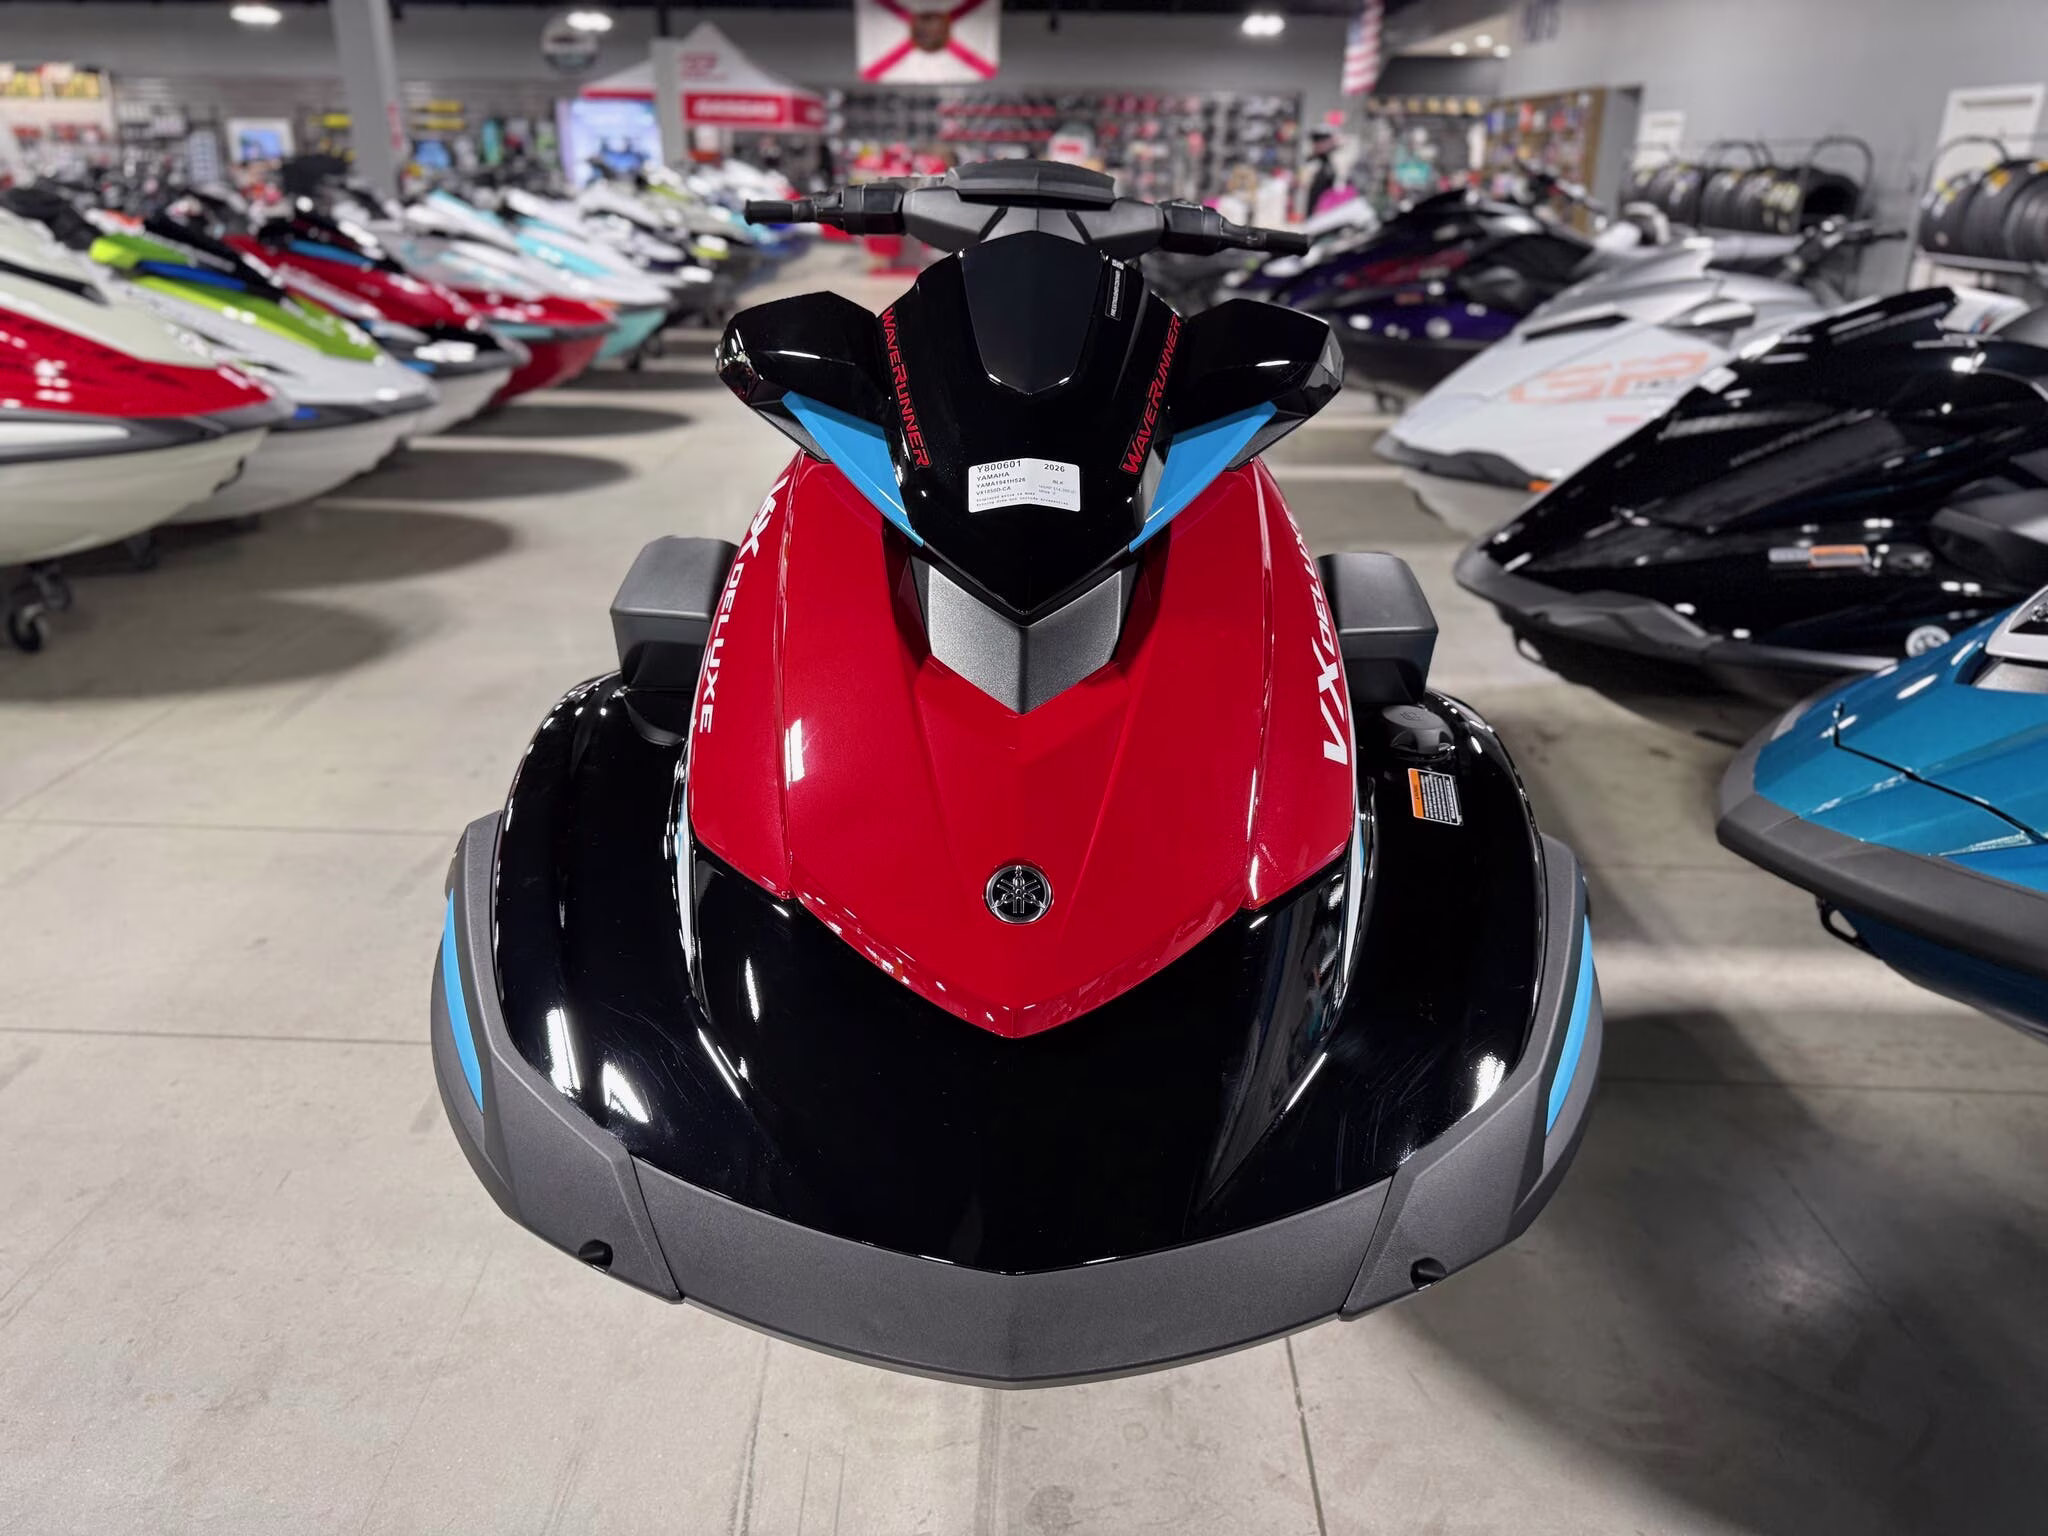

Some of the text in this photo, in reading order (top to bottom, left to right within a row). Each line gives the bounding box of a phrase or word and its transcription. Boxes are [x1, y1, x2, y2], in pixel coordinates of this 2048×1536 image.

[881, 306, 931, 468] WAVERUNNER
[1122, 313, 1181, 473] WAVERUNNER
[976, 472, 1010, 481] YAMAHA
[977, 460, 1065, 472] Y800601 2026
[700, 562, 745, 734] DELUXE
[1312, 637, 1348, 765] VX
